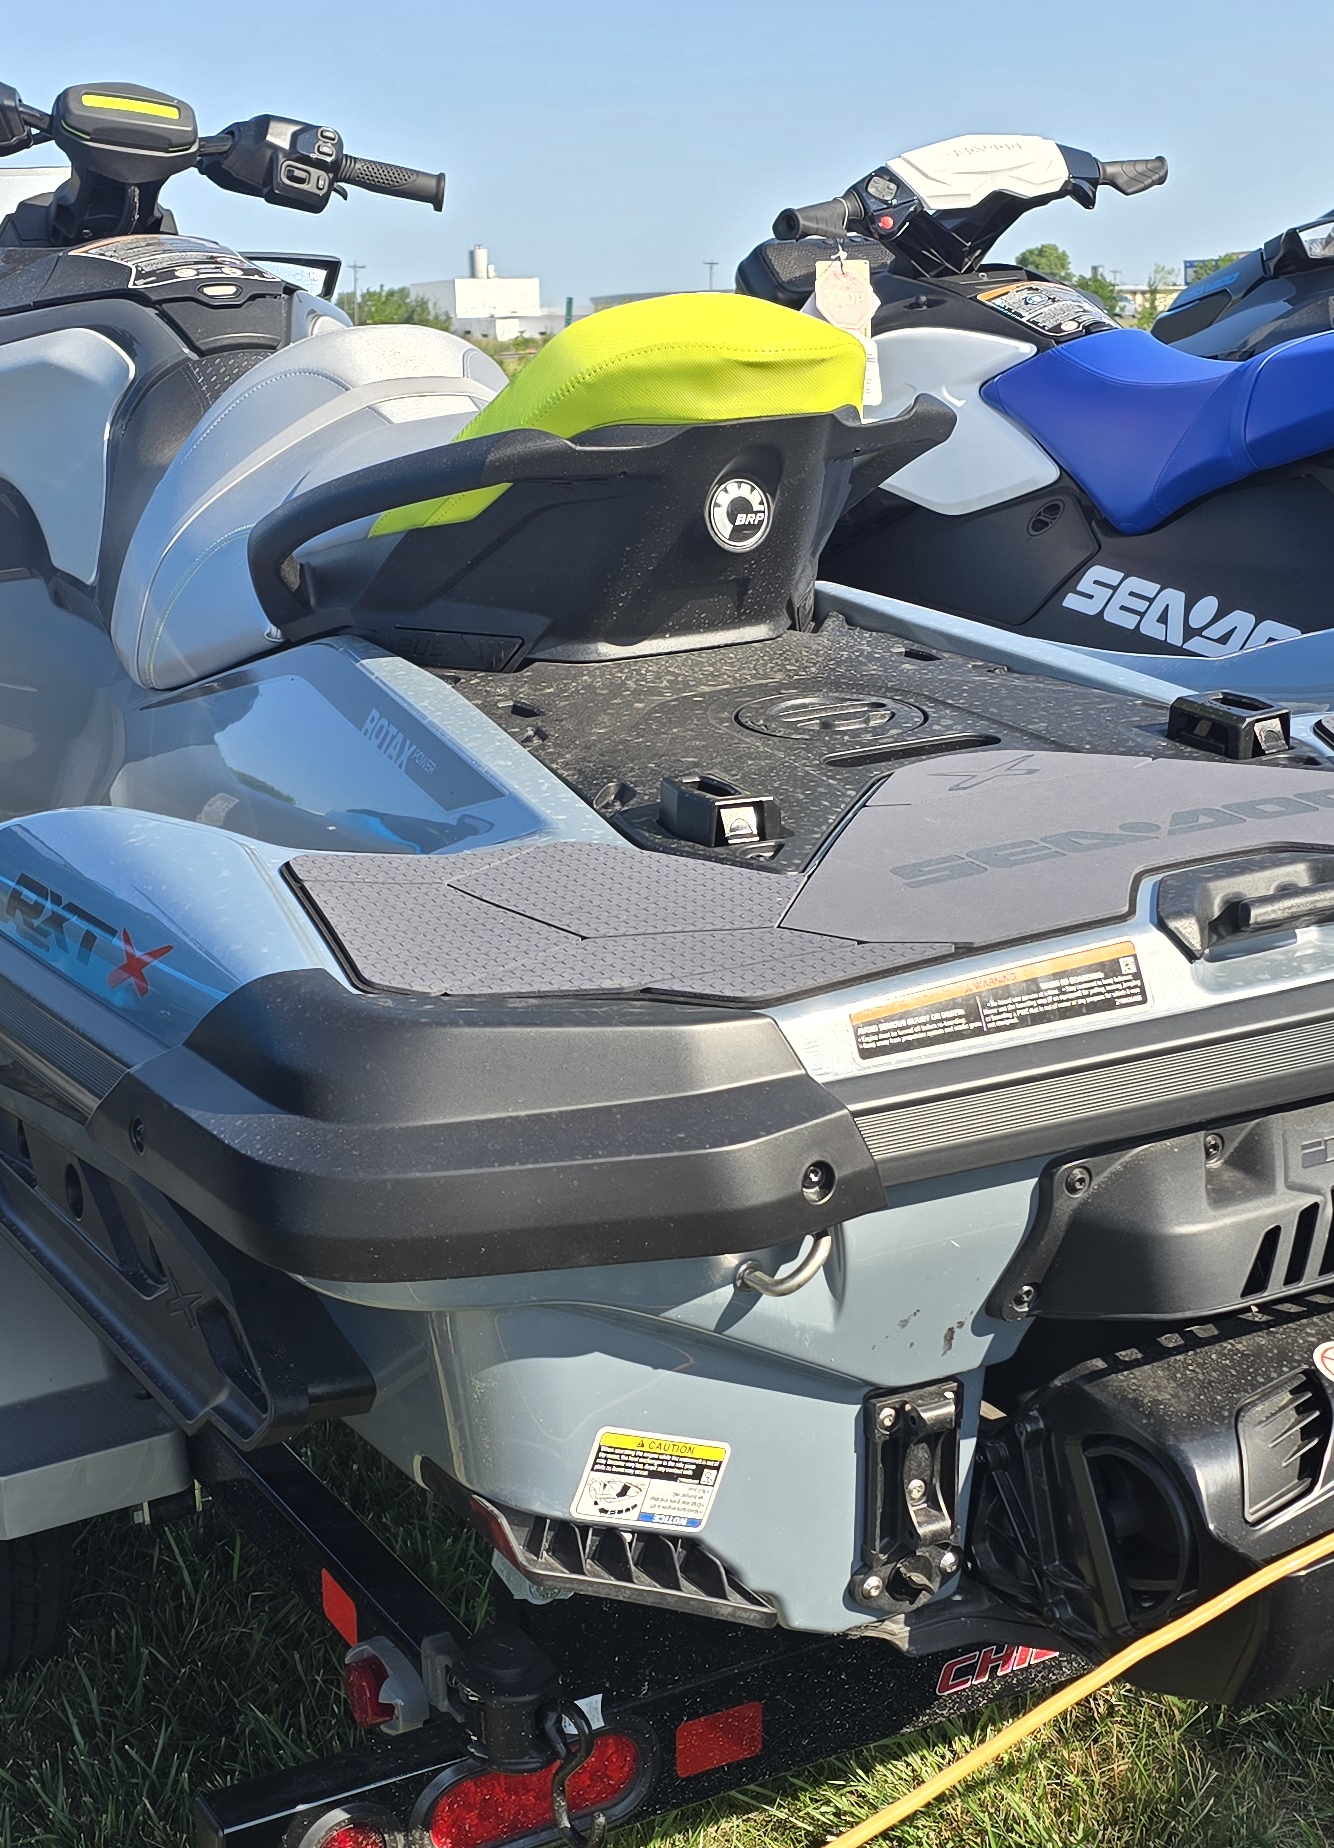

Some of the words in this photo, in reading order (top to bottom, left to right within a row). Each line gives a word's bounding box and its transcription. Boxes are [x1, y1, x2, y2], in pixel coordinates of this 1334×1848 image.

[735, 513, 765, 526] BRP
[361, 708, 416, 773] ROTAX
[412, 748, 437, 776] POWER
[4, 872, 118, 966] RXT
[107, 927, 174, 998] X
[973, 972, 1017, 991] WARNING
[648, 1440, 696, 1455] CAUTION
[652, 1513, 688, 1526] NOTICE
[936, 1644, 1060, 1696] CHI
